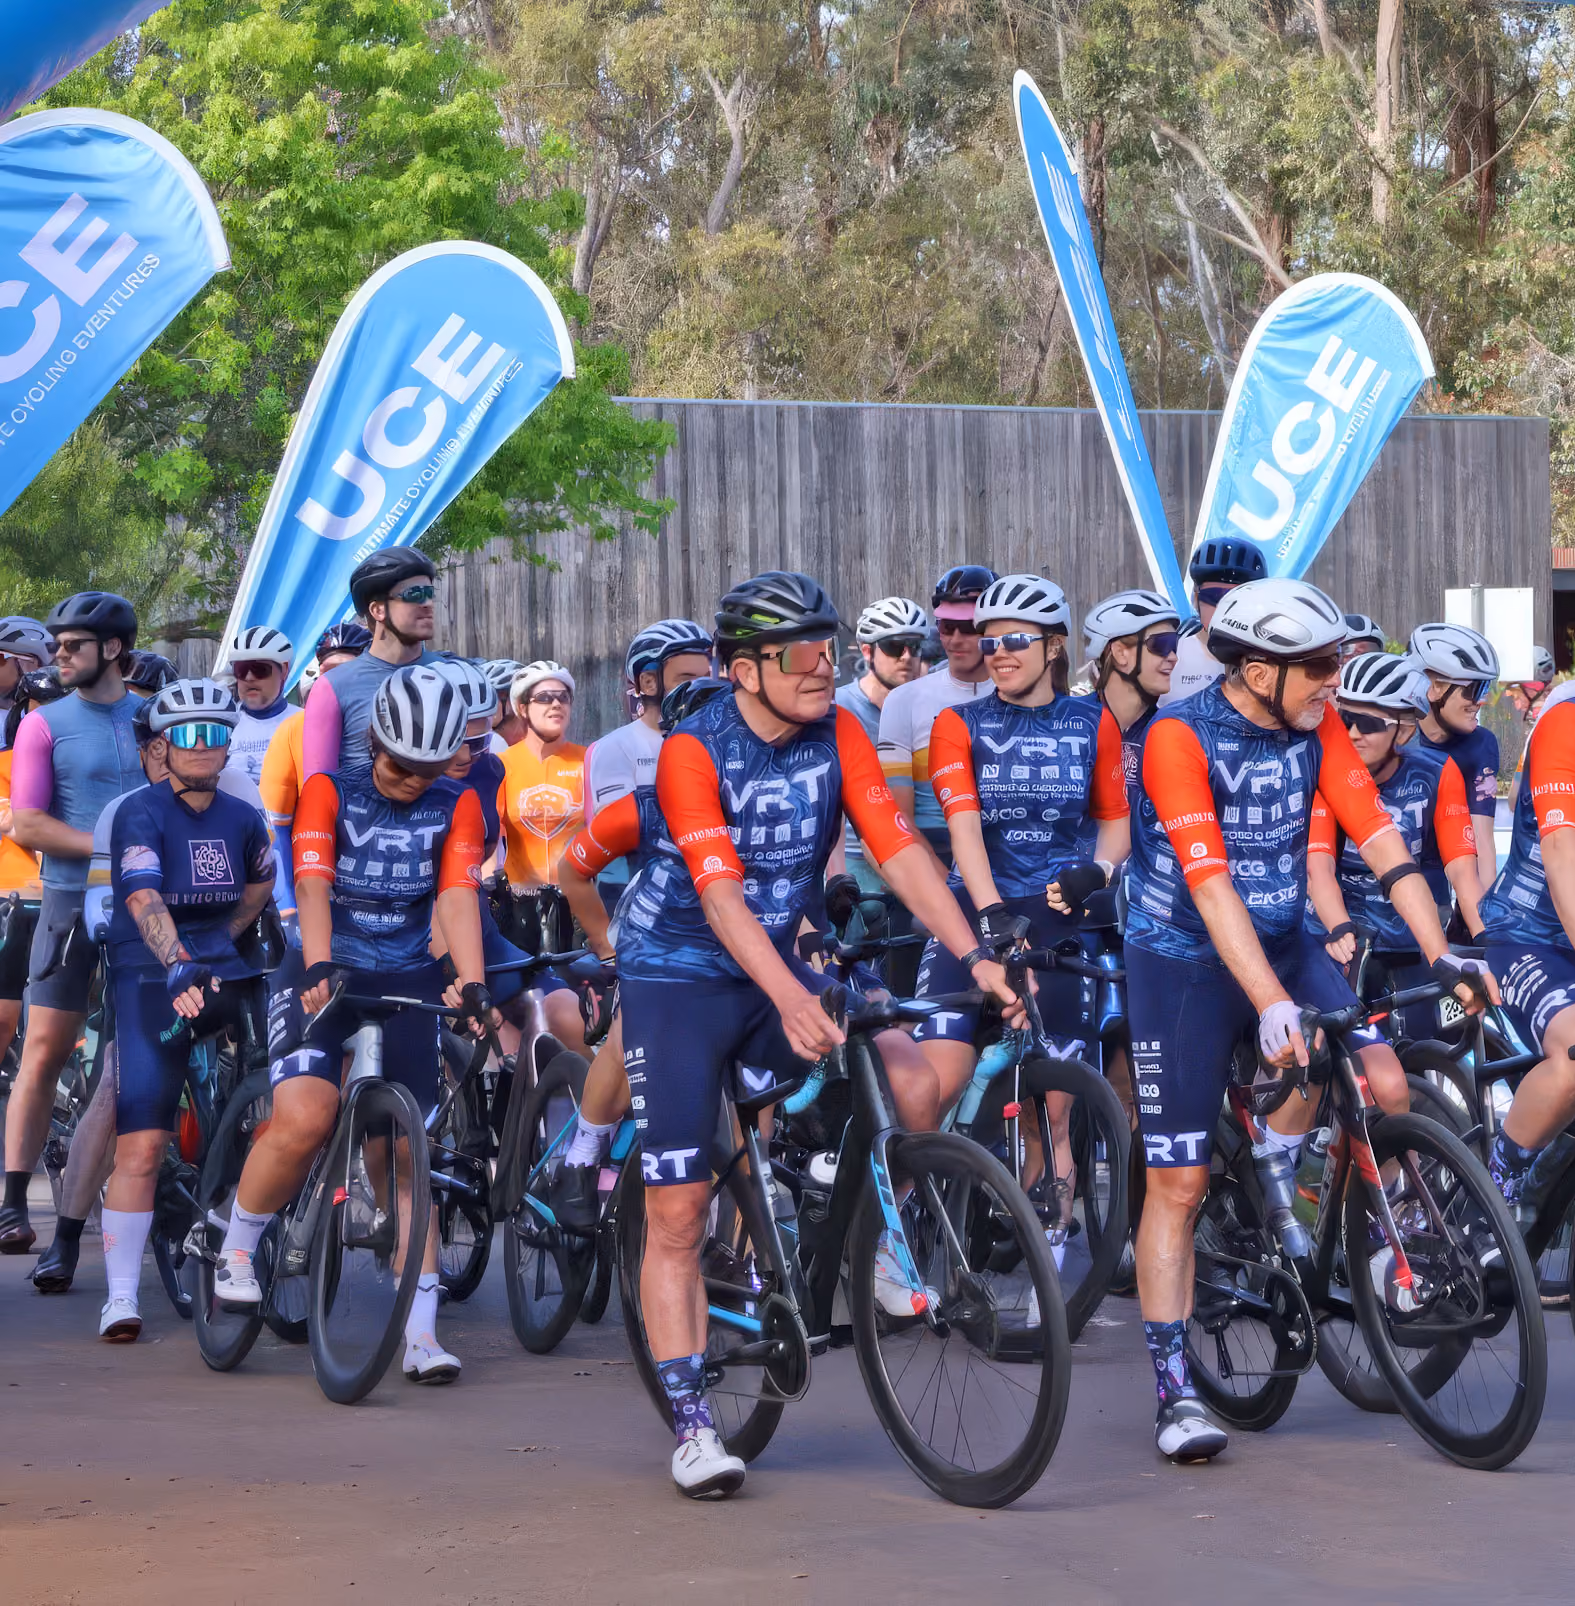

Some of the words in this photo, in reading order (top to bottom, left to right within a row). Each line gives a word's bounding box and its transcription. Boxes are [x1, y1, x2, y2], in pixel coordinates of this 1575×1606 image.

[72, 253, 160, 350] EVENTURES
[295, 312, 506, 541] UCE
[1227, 334, 1378, 541] UCE
[980, 733, 1091, 758] VRT
[1214, 739, 1308, 794] VRT
[722, 760, 832, 815] VRT
[343, 818, 447, 853] VRT
[641, 1147, 700, 1181] RT
[1143, 1131, 1208, 1162] RT
